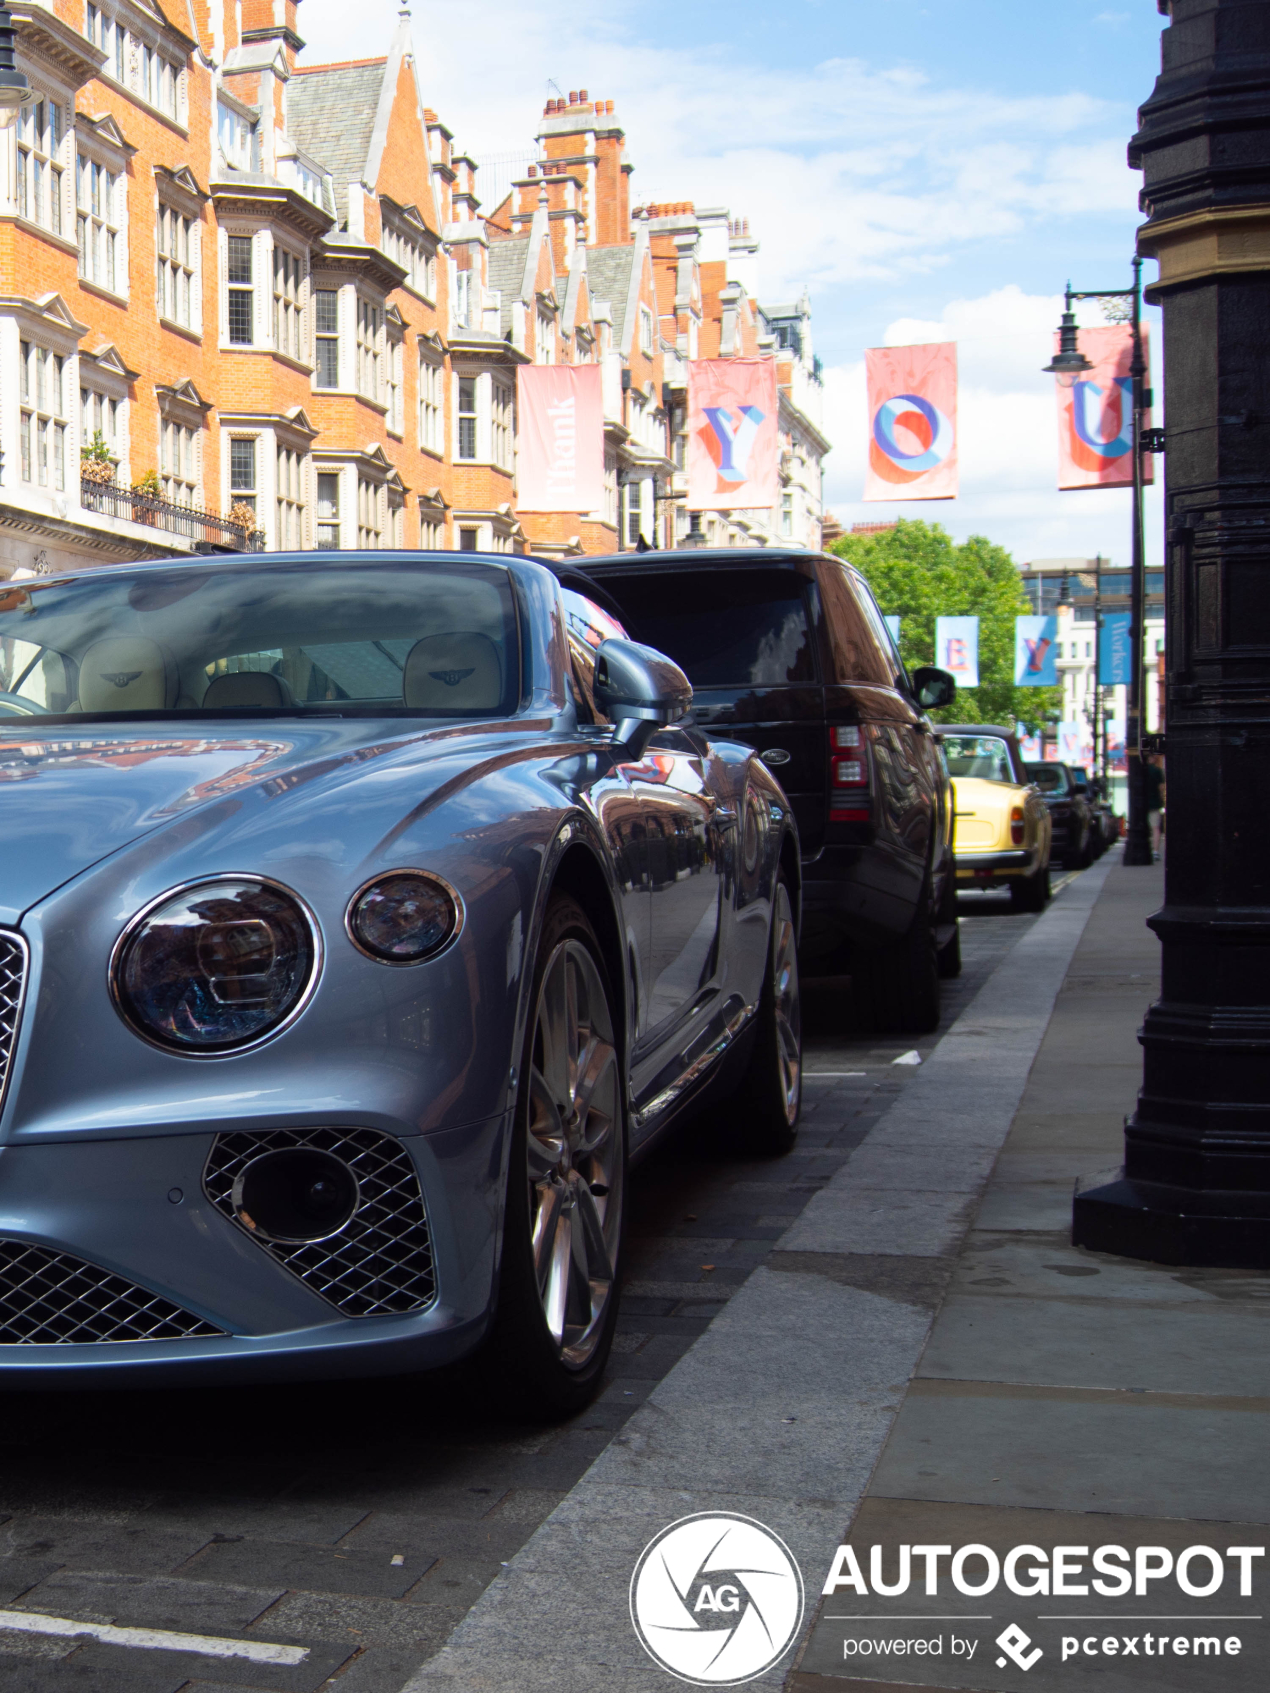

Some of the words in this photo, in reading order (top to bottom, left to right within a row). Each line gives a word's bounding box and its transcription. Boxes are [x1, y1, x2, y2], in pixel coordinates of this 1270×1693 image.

[546, 396, 575, 497] Thank
[702, 405, 766, 481] Y
[873, 394, 953, 472] O
[946, 638, 970, 671] E
[1024, 638, 1052, 671] Y
[1112, 621, 1127, 683] Workers
